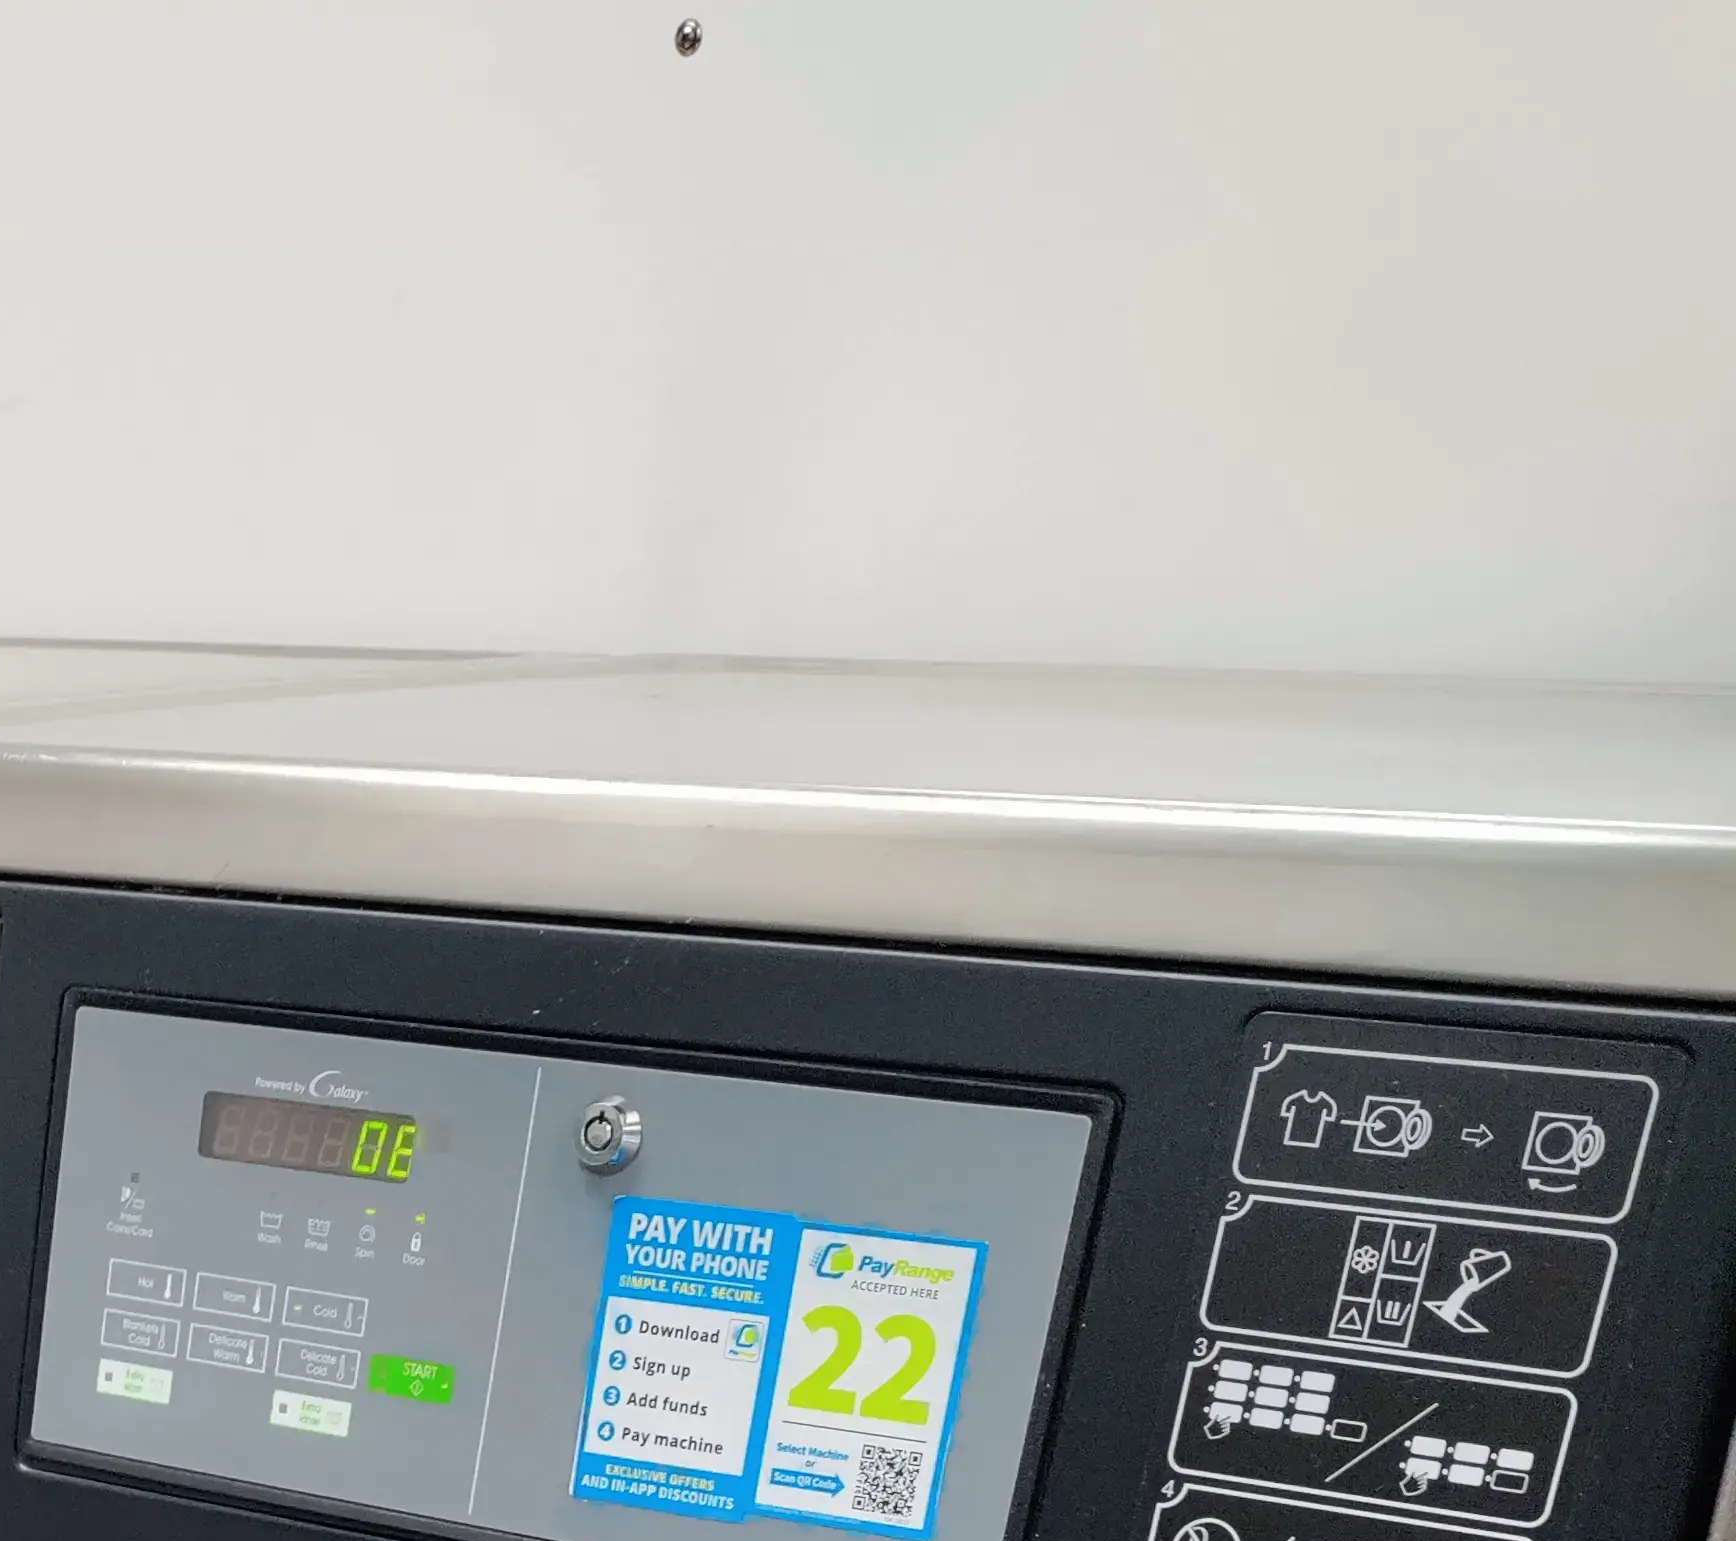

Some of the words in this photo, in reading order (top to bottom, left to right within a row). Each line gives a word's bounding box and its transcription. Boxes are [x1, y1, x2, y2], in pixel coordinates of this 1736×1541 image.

[1262, 1041, 1273, 1061] 1
[254, 1077, 293, 1091] Powered
[294, 1081, 306, 1095] by
[1223, 1190, 1242, 1211] 2
[627, 1212, 687, 1245] PAY
[692, 1219, 774, 1256] WITH
[402, 1252, 426, 1266] Door
[625, 1243, 687, 1272] YOUR
[690, 1251, 770, 1281] PHONE
[858, 1255, 956, 1284] PayRange
[851, 1279, 908, 1297] ACCEPTED
[910, 1287, 940, 1300] HERE
[313, 1304, 338, 1319] Cold
[639, 1319, 721, 1344] Download
[1193, 1337, 1209, 1357] 3
[402, 1362, 438, 1380] START
[632, 1356, 666, 1376] Sign
[671, 1364, 691, 1380] up
[787, 1304, 937, 1426] 22
[626, 1392, 659, 1409] Add
[662, 1396, 708, 1417] funds
[621, 1427, 650, 1447] Pay
[654, 1433, 724, 1455] machine
[776, 1442, 806, 1457] Select
[808, 1446, 850, 1461] Machine
[605, 1463, 667, 1484] EXCLUSIVE
[669, 1474, 716, 1492] OFFERS
[1160, 1479, 1175, 1498] 4
[581, 1474, 609, 1489] AND
[611, 1478, 657, 1497] IN-APP
[658, 1485, 735, 1510] DISCOUNTS
